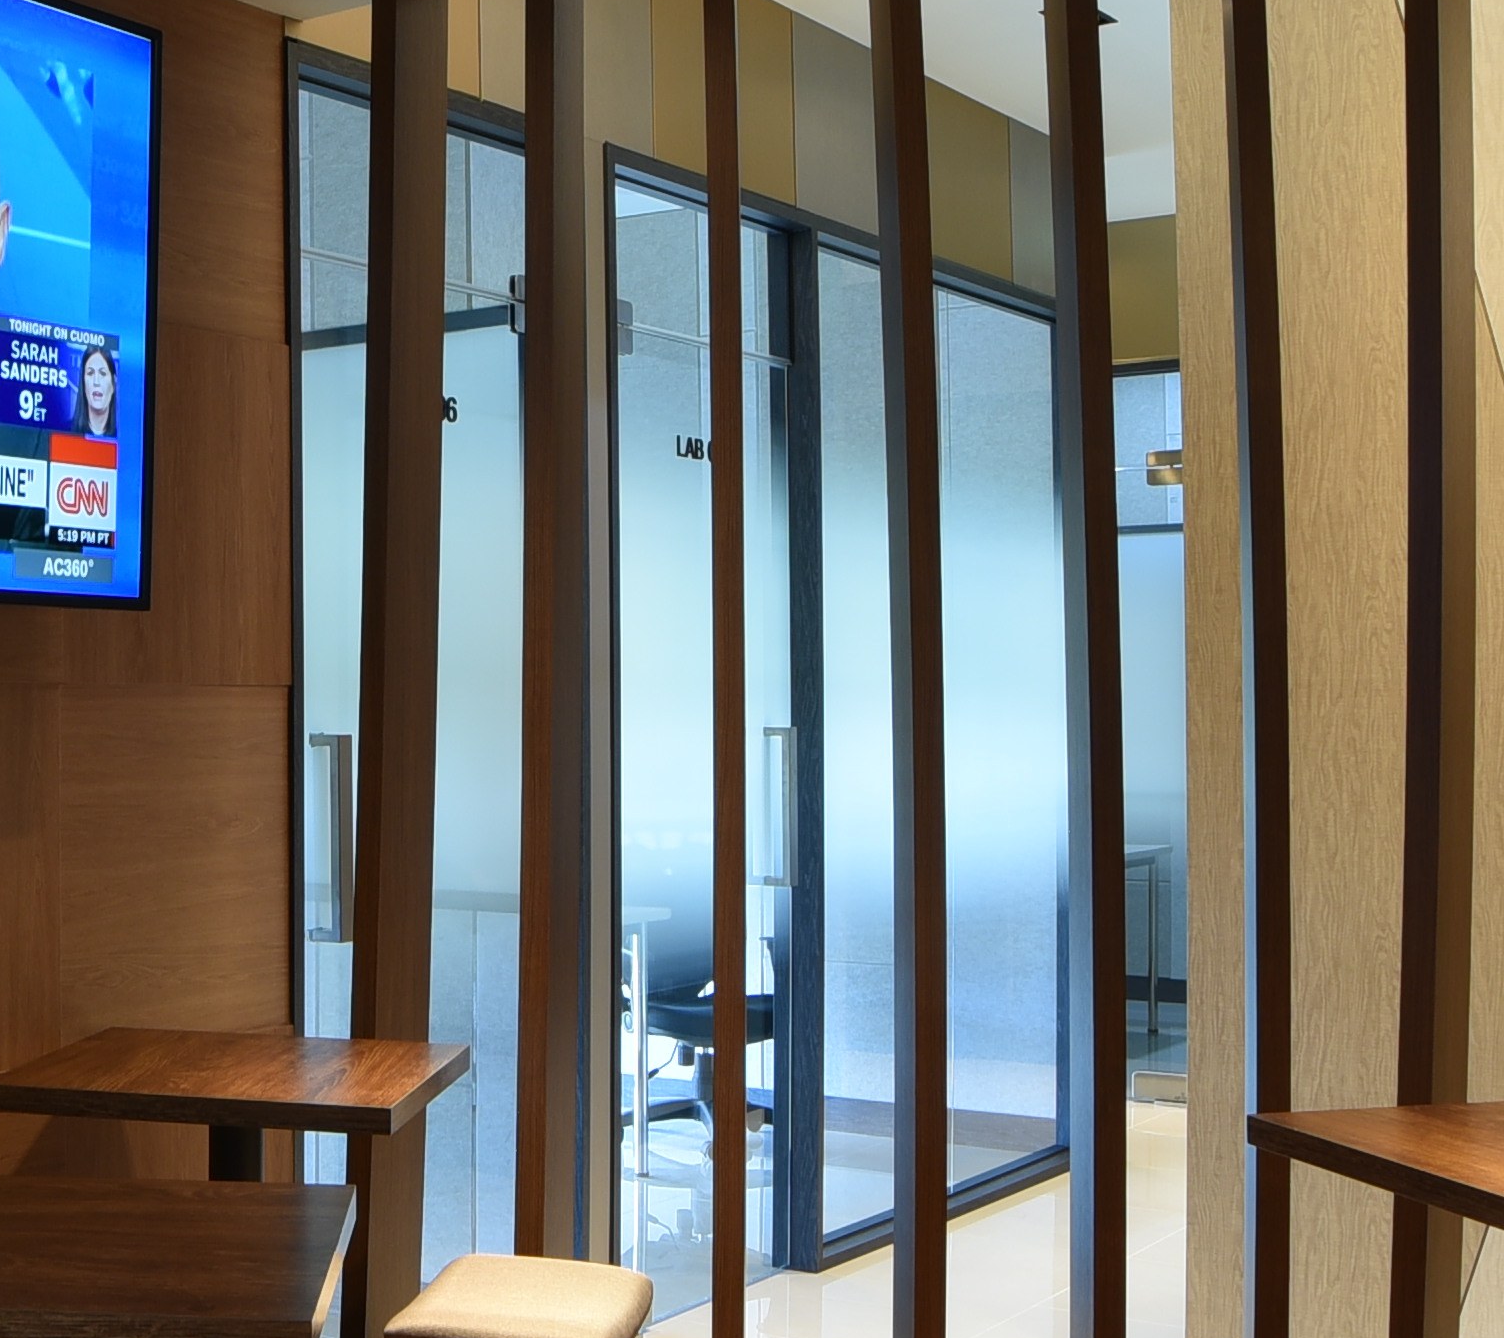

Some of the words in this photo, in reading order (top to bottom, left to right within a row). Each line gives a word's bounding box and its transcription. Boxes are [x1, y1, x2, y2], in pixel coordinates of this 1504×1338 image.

[9, 318, 52, 337] TONIGHT
[54, 326, 67, 340] ON
[70, 329, 105, 346] CUOMO
[10, 340, 59, 365] SARAH
[0, 360, 68, 388] SANDERS
[33, 408, 47, 422] ET
[676, 434, 705, 460] LAB
[57, 476, 109, 518] CNN
[57, 528, 79, 543] 5:19
[80, 531, 96, 544] PM
[98, 532, 110, 545] PT
[43, 556, 95, 578] AC360°
